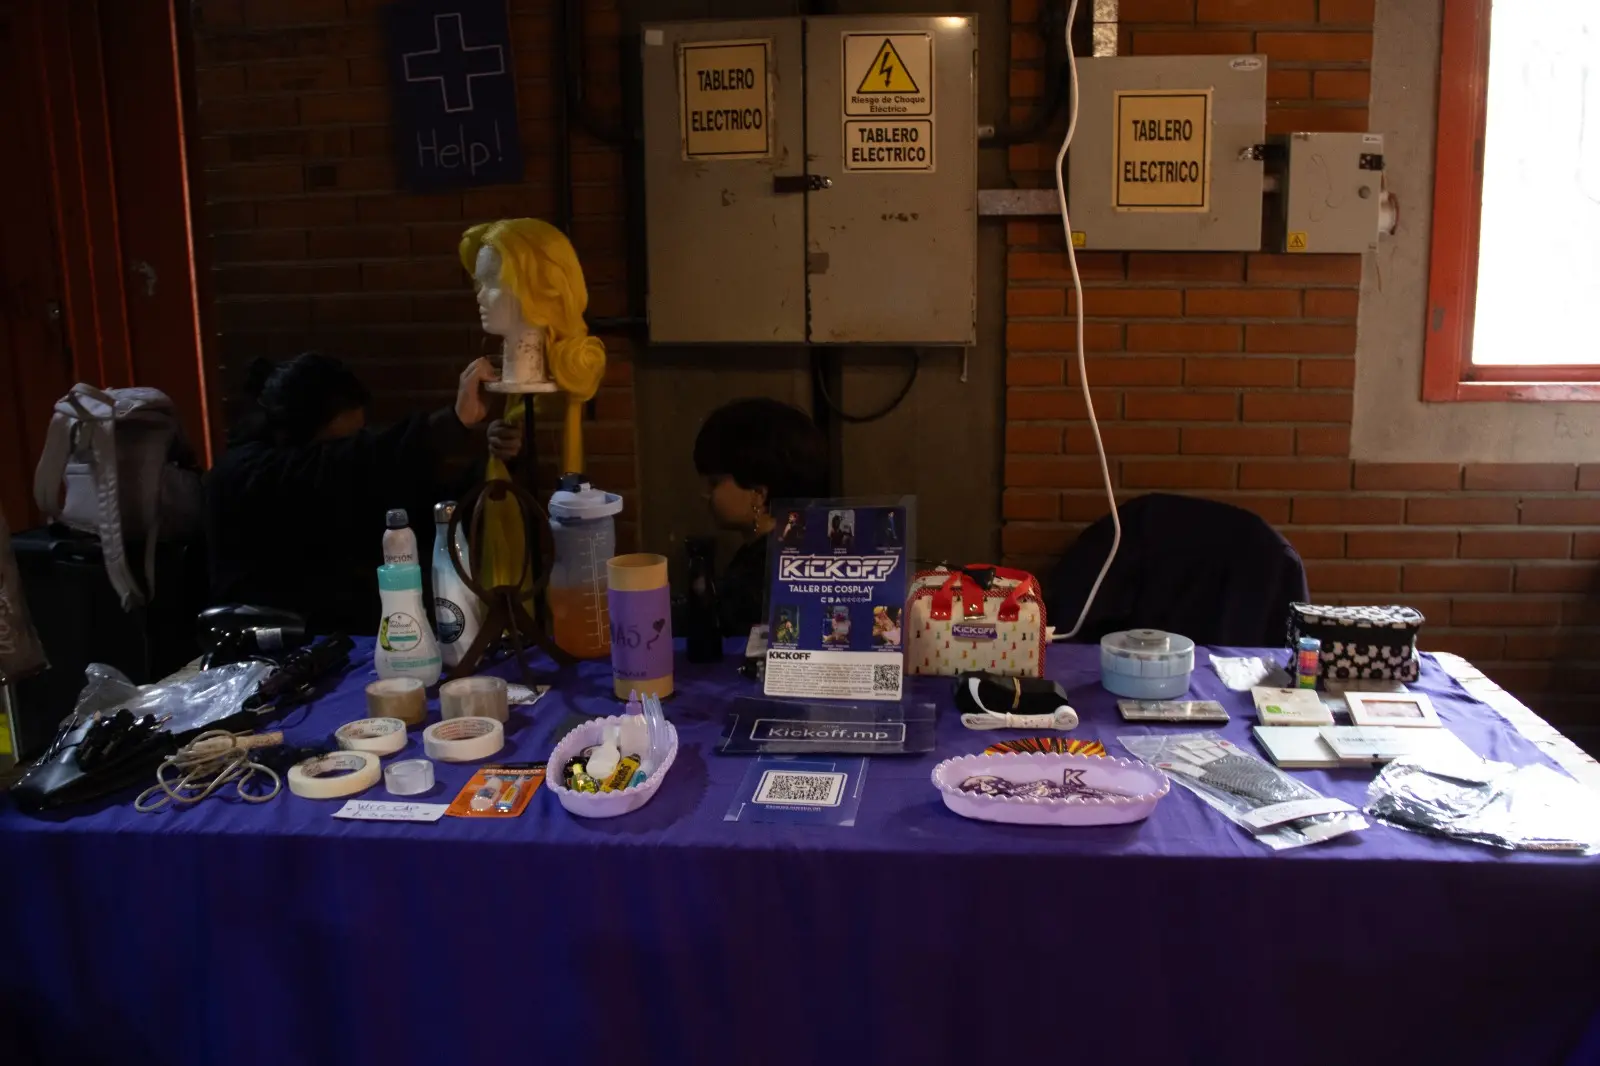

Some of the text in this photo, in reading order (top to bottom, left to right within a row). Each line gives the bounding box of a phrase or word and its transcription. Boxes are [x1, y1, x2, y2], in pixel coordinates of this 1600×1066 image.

[697, 69, 755, 90] TABLERO
[851, 96, 926, 105] Riesgo de Choque
[692, 109, 763, 132] ELECTRICO
[858, 128, 918, 142] TABLERO
[1131, 119, 1193, 142] TABLERO
[416, 119, 503, 177] Help!
[852, 147, 926, 162] ELECTRICO
[1123, 160, 1199, 183] ELECTRICO
[788, 584, 874, 595] TALLER DE COSPLAY
[768, 651, 812, 661] KICKOFF
[768, 727, 889, 740] Kickoff.mp
[1063, 768, 1087, 787] K
